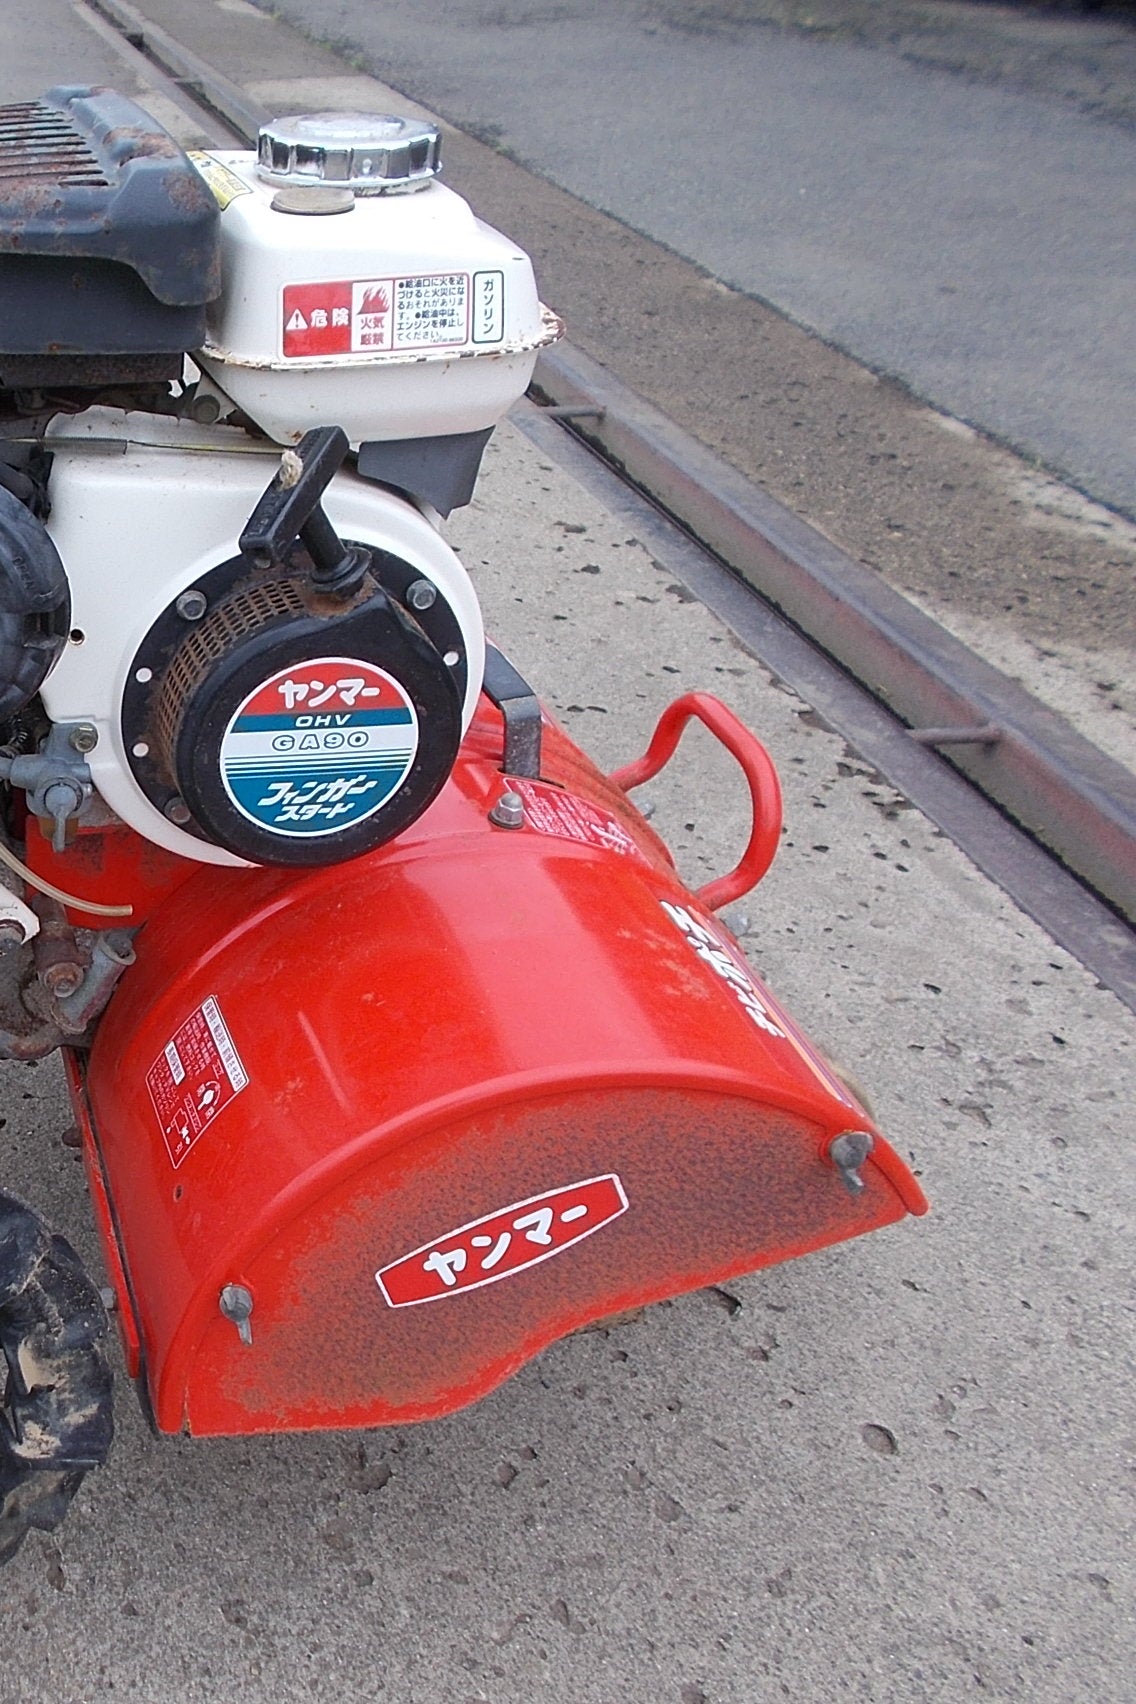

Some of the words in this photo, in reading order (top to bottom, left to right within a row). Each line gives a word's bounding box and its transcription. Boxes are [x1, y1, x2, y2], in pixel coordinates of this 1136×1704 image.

[397, 287, 465, 299] づけると火災にな
[397, 298, 465, 310] るおそれがありま
[481, 279, 495, 335] ガソリン
[310, 307, 350, 329] 危険
[360, 316, 385, 330] 火気
[397, 318, 464, 330] エンジンを停止し
[278, 678, 380, 709] ヤンマー
[295, 714, 352, 728] OHV
[272, 731, 369, 751] GA90
[257, 775, 378, 806] フィンガー
[274, 803, 355, 822] スタート
[423, 1205, 588, 1286] ヤンマー
